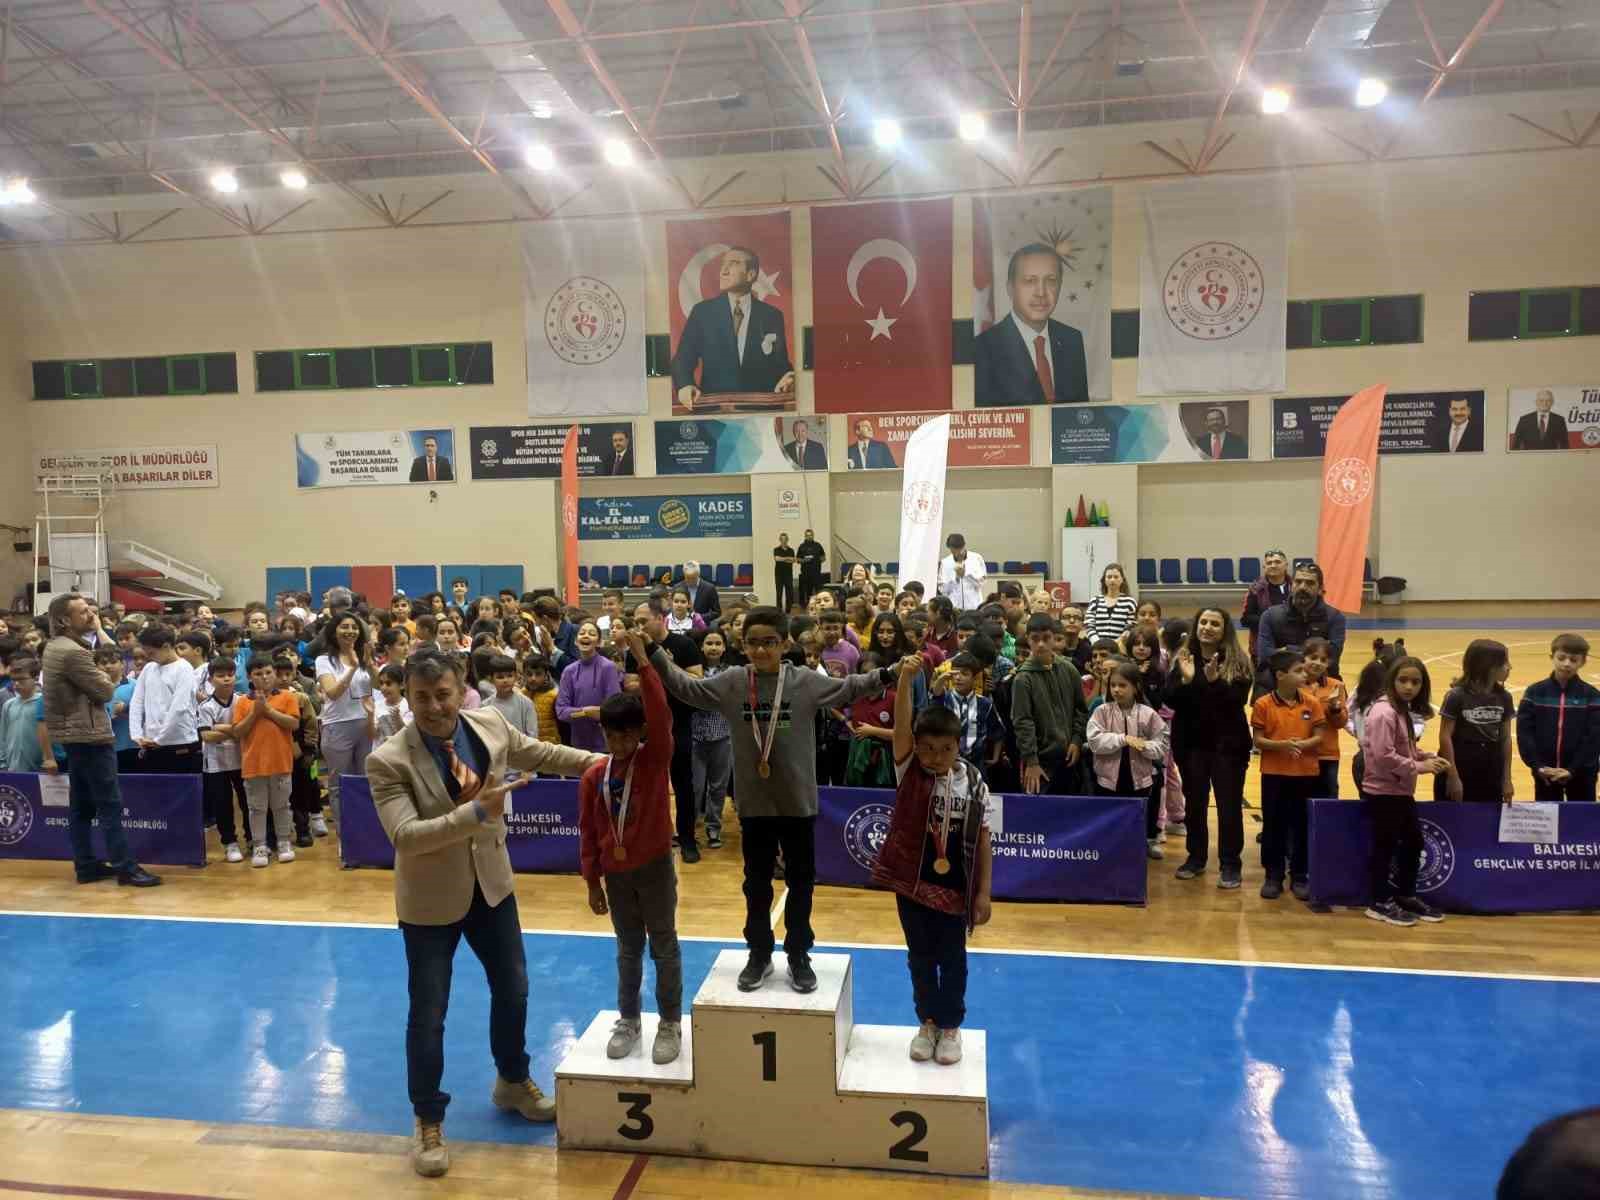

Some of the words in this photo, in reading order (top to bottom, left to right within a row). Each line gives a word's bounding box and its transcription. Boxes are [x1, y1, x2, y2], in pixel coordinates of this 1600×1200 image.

[1582, 389, 1600, 404] Tü
[879, 415, 895, 427] BEN
[967, 413, 991, 427] ÇEVİK
[992, 413, 1004, 424] VE
[1005, 412, 1025, 423] AYNI
[1568, 406, 1600, 424] Üstü
[131, 455, 139, 465] İL
[142, 451, 208, 467] MÜDÜRLÜĞÜ
[336, 449, 351, 457] TÜM
[122, 472, 180, 485] BAŞARILAR
[182, 469, 213, 482] DİLER
[699, 501, 744, 512] KADES
[507, 812, 562, 824] BALIKESİR
[515, 826, 538, 835] SPOR
[540, 824, 549, 834] İL
[990, 832, 1045, 846] ALIKESİR
[992, 846, 1017, 857] SPOR
[1020, 845, 1030, 857] İL
[1031, 845, 1100, 861] MÜDÜRLÜĞÜ
[1533, 843, 1600, 855] BALIKESİ
[1474, 858, 1525, 871] GENÇLİK
[1527, 859, 1544, 870] VE
[1546, 859, 1577, 871] SPOR
[1580, 859, 1591, 871] İL
[752, 1031, 777, 1082] 1
[617, 1093, 654, 1140] 3
[889, 1110, 929, 1163] 2
